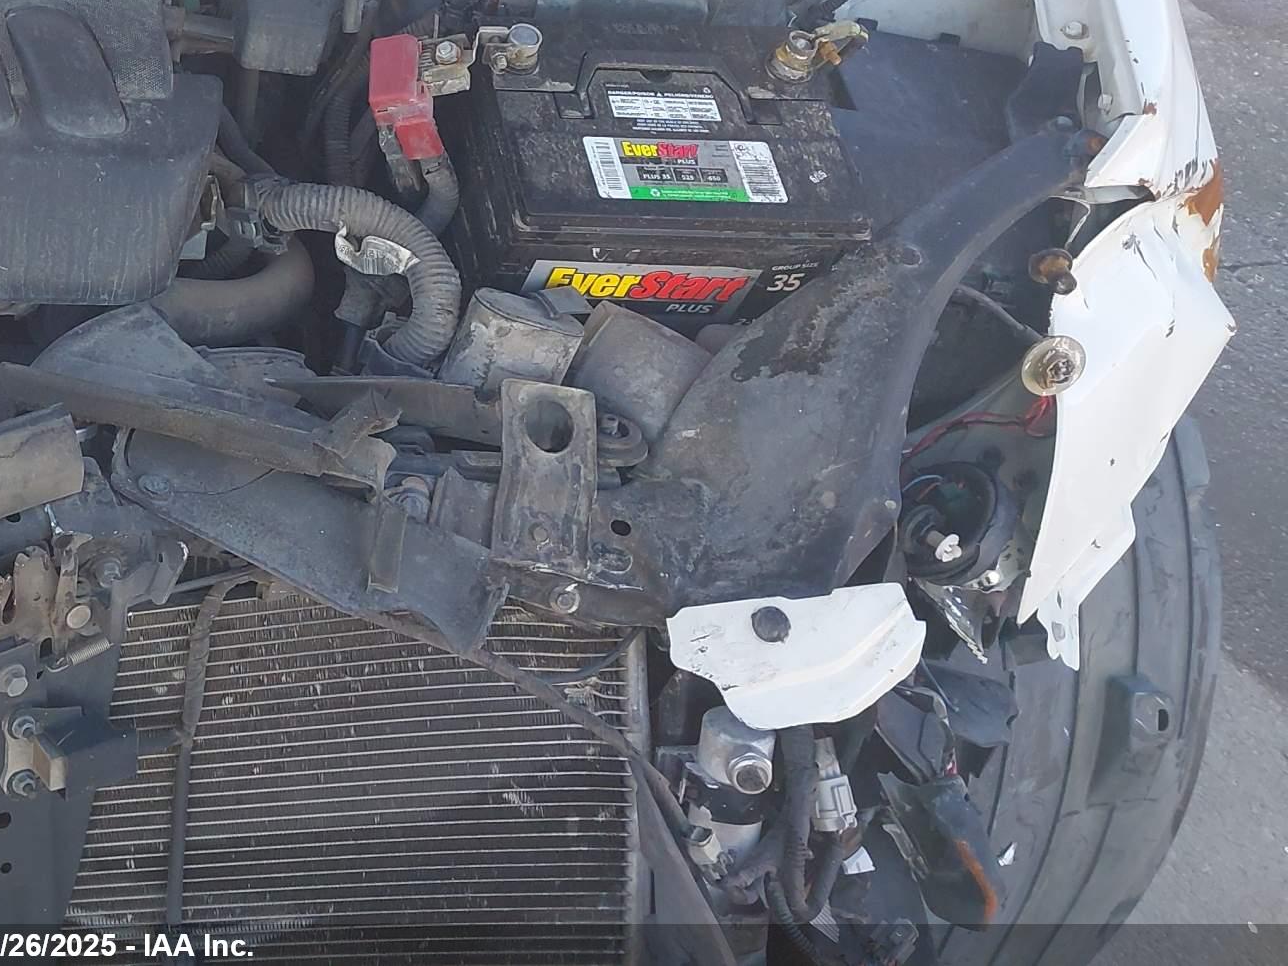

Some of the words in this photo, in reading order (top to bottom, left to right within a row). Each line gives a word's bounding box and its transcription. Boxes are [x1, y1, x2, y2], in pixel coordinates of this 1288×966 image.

[621, 141, 699, 159] EverStart
[545, 267, 751, 302] EverStart
[766, 273, 806, 292] 35
[664, 303, 714, 314] PLUS
